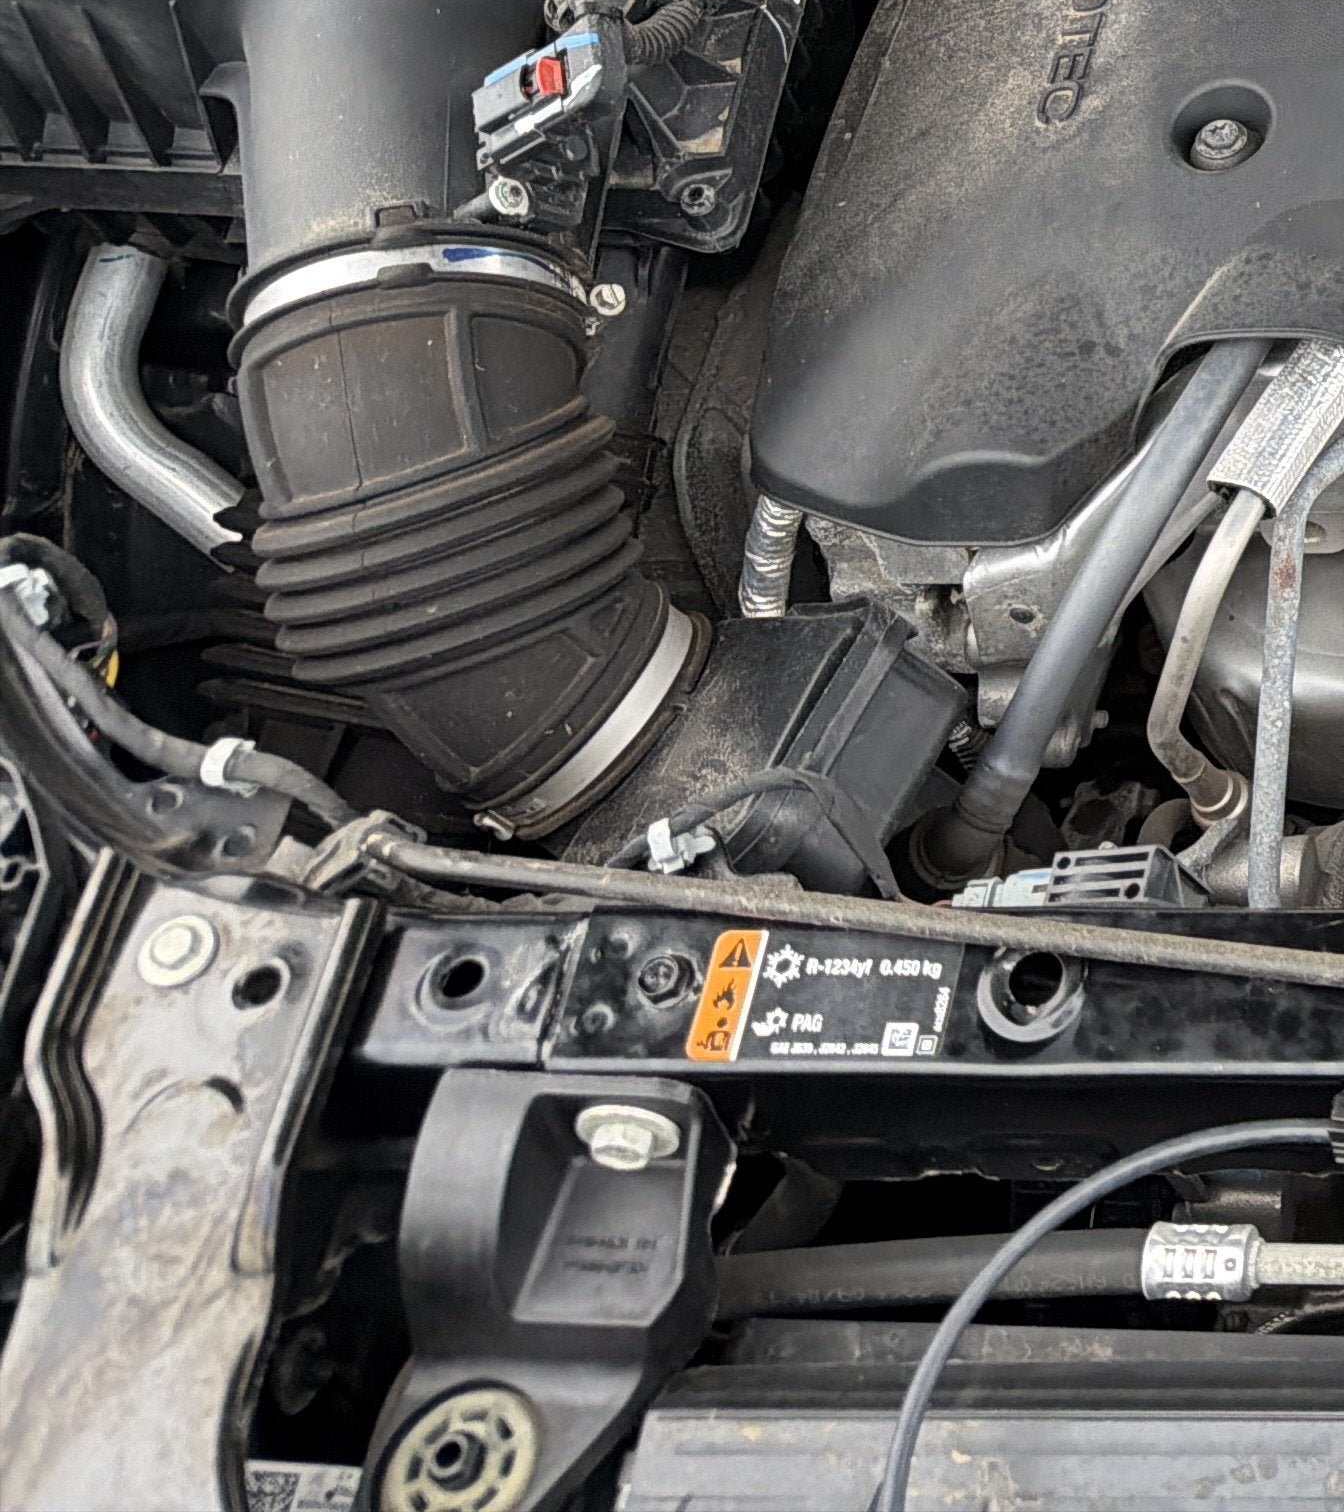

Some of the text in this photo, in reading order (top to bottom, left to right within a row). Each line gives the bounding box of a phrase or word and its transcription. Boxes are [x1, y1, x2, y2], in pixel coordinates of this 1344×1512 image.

[878, 958, 921, 977] 0.450
[922, 959, 943, 980] kg
[791, 1013, 823, 1033] PAG
